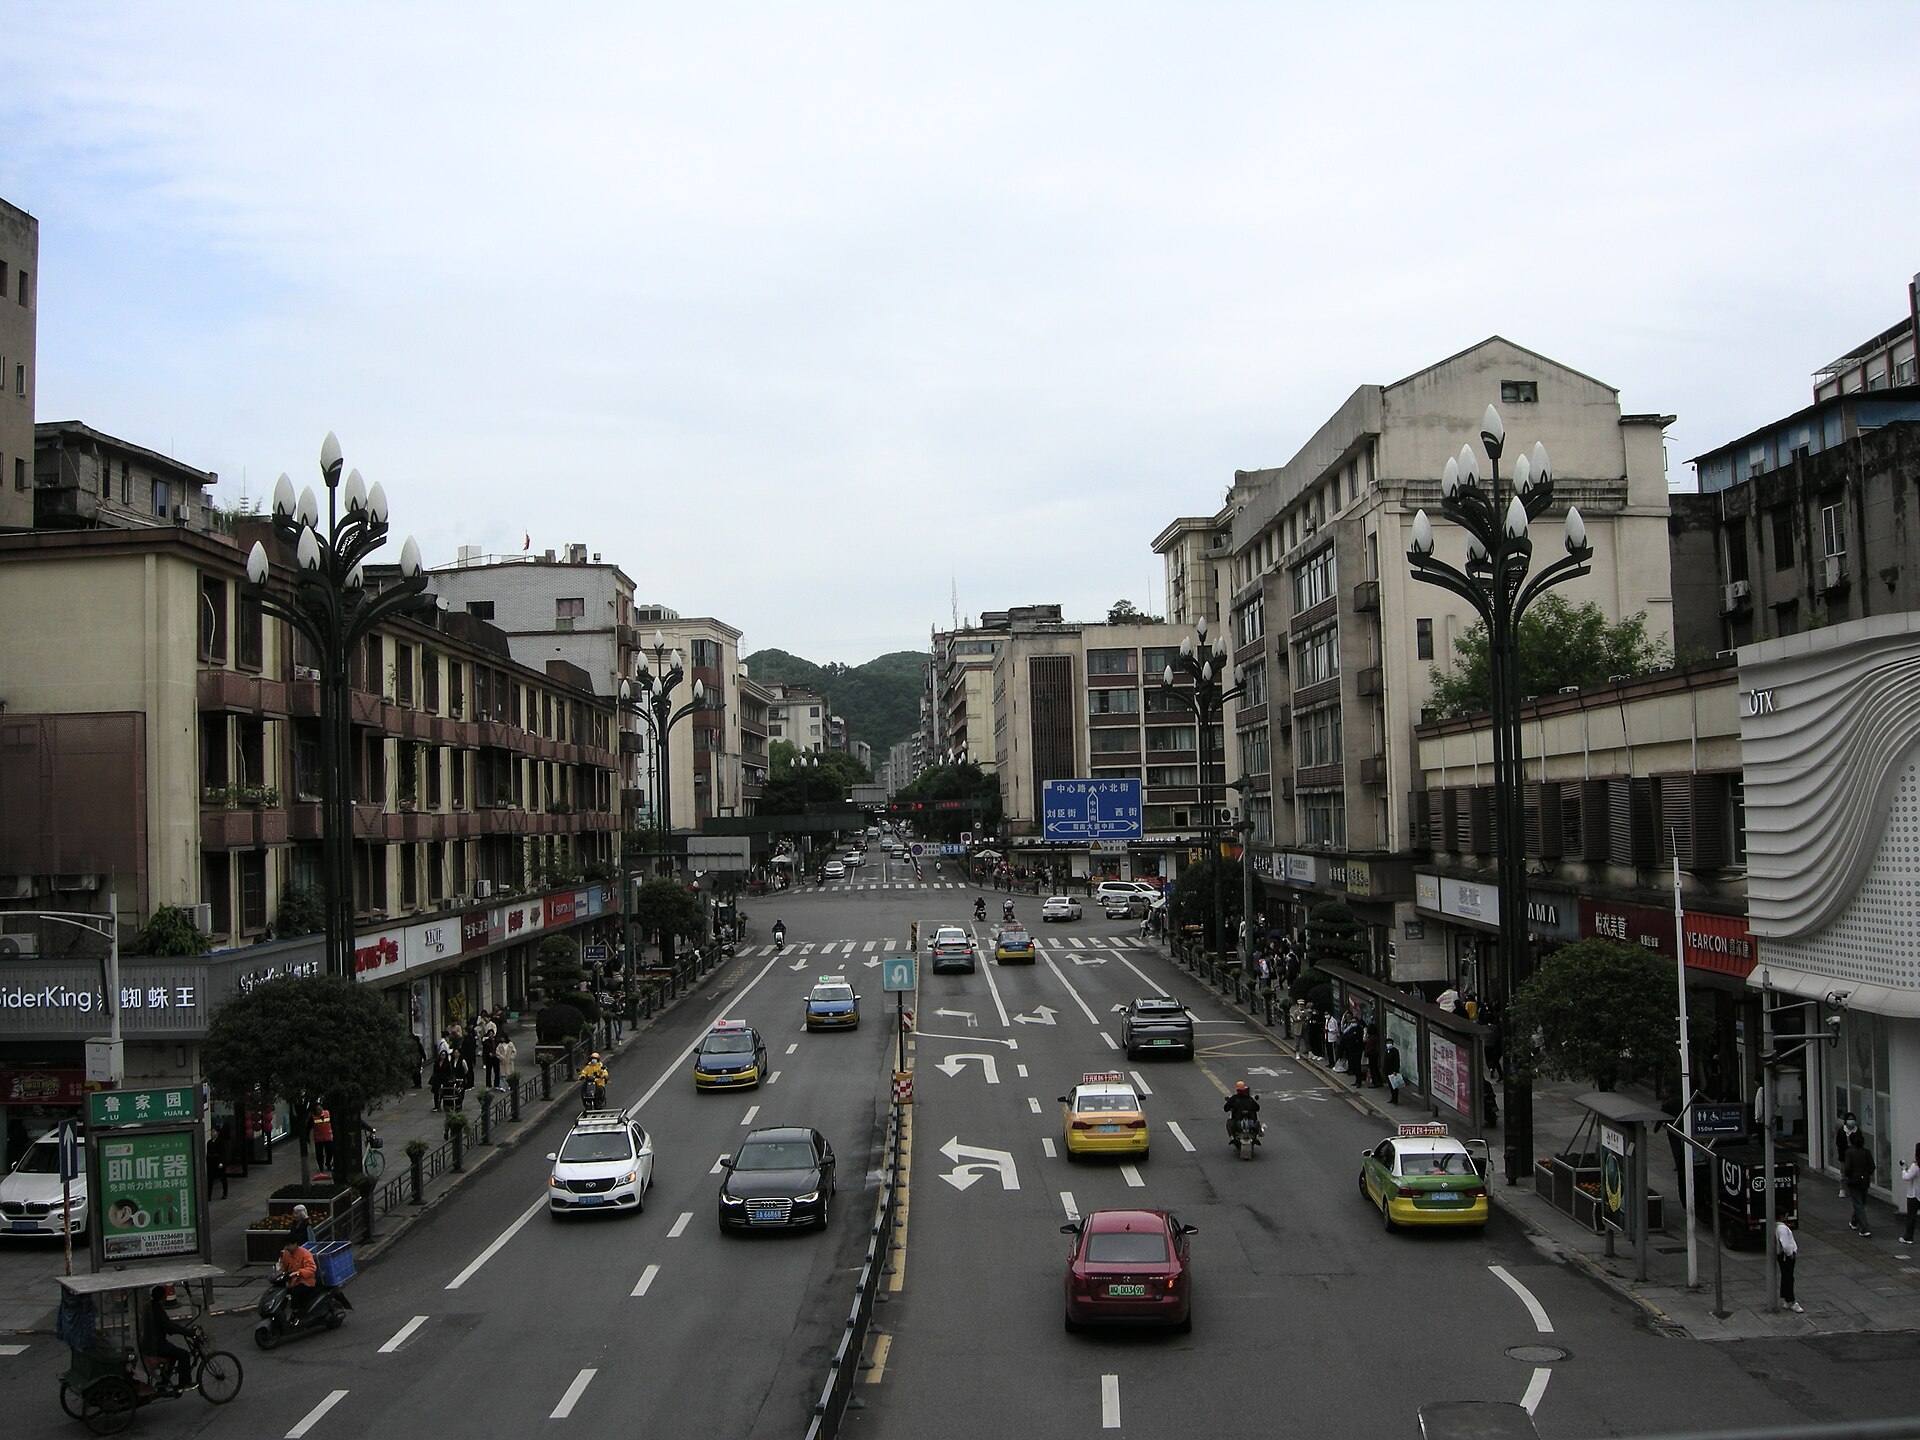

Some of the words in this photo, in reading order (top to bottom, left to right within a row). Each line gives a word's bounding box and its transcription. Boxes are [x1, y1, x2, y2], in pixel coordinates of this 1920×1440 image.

[1057, 784, 1086, 793] 中心路
[1099, 783, 1129, 793] 小北街
[1047, 808, 1076, 818] 刘臣街
[1115, 807, 1137, 817] 西街
[1686, 931, 1728, 953] YEARCON
[1729, 938, 1750, 958] 意尔康
[0, 985, 93, 1013] iderKing
[120, 986, 196, 1009] 蜘蛛王
[104, 1091, 182, 1112] 鲁家园
[108, 1154, 188, 1182] 助听器
[109, 1179, 188, 1193] 免费听力检测及评估
